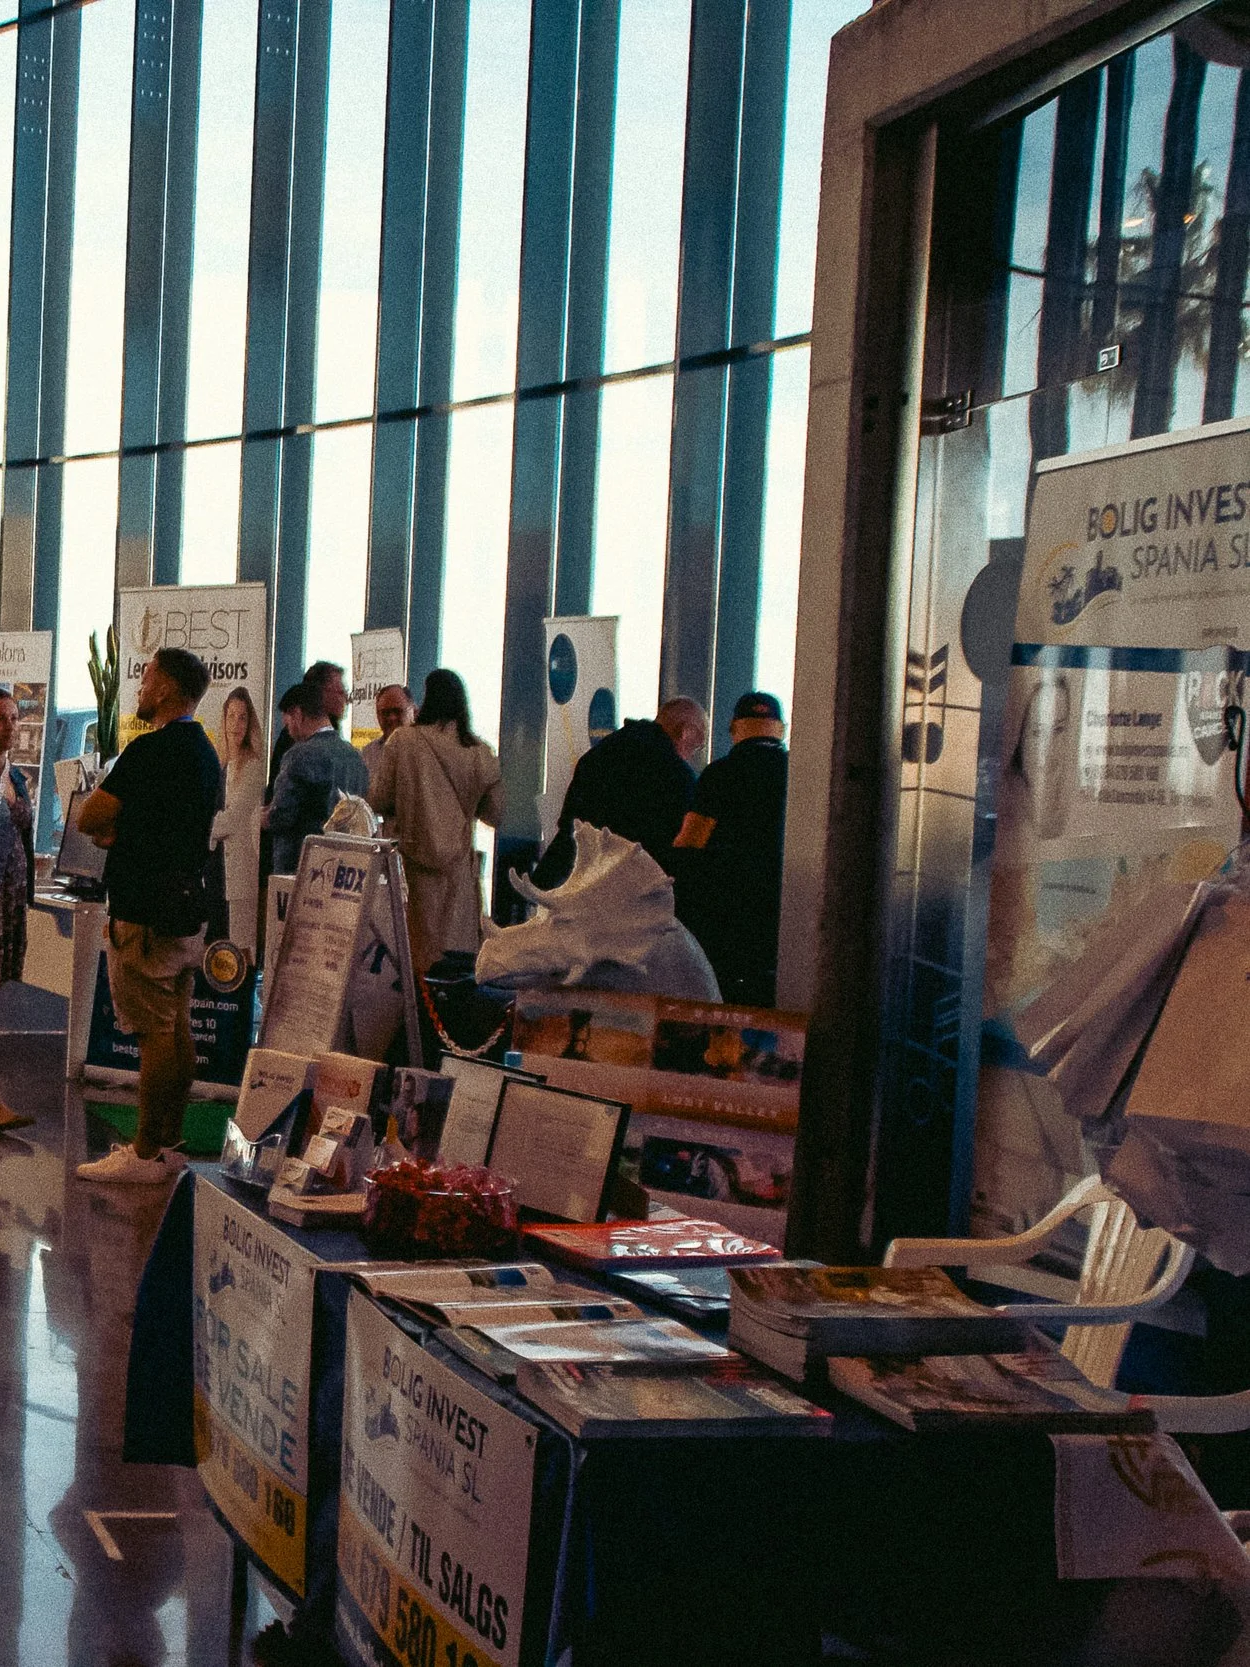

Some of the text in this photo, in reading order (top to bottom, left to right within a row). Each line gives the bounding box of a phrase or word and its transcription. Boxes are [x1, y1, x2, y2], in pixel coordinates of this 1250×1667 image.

[1087, 481, 1250, 543] BOLIG INVES
[1131, 537, 1218, 579] SPANIA
[164, 609, 250, 649] BEST
[223, 1214, 292, 1288] BOLIG INVEST
[218, 1368, 297, 1477] VENDE
[236, 1339, 298, 1423] SALE
[383, 1346, 489, 1458] BOLIG INVEST
[406, 1414, 481, 1504] SPANIA SL
[411, 1521, 432, 1589] TIL
[439, 1552, 508, 1650] SALGS
